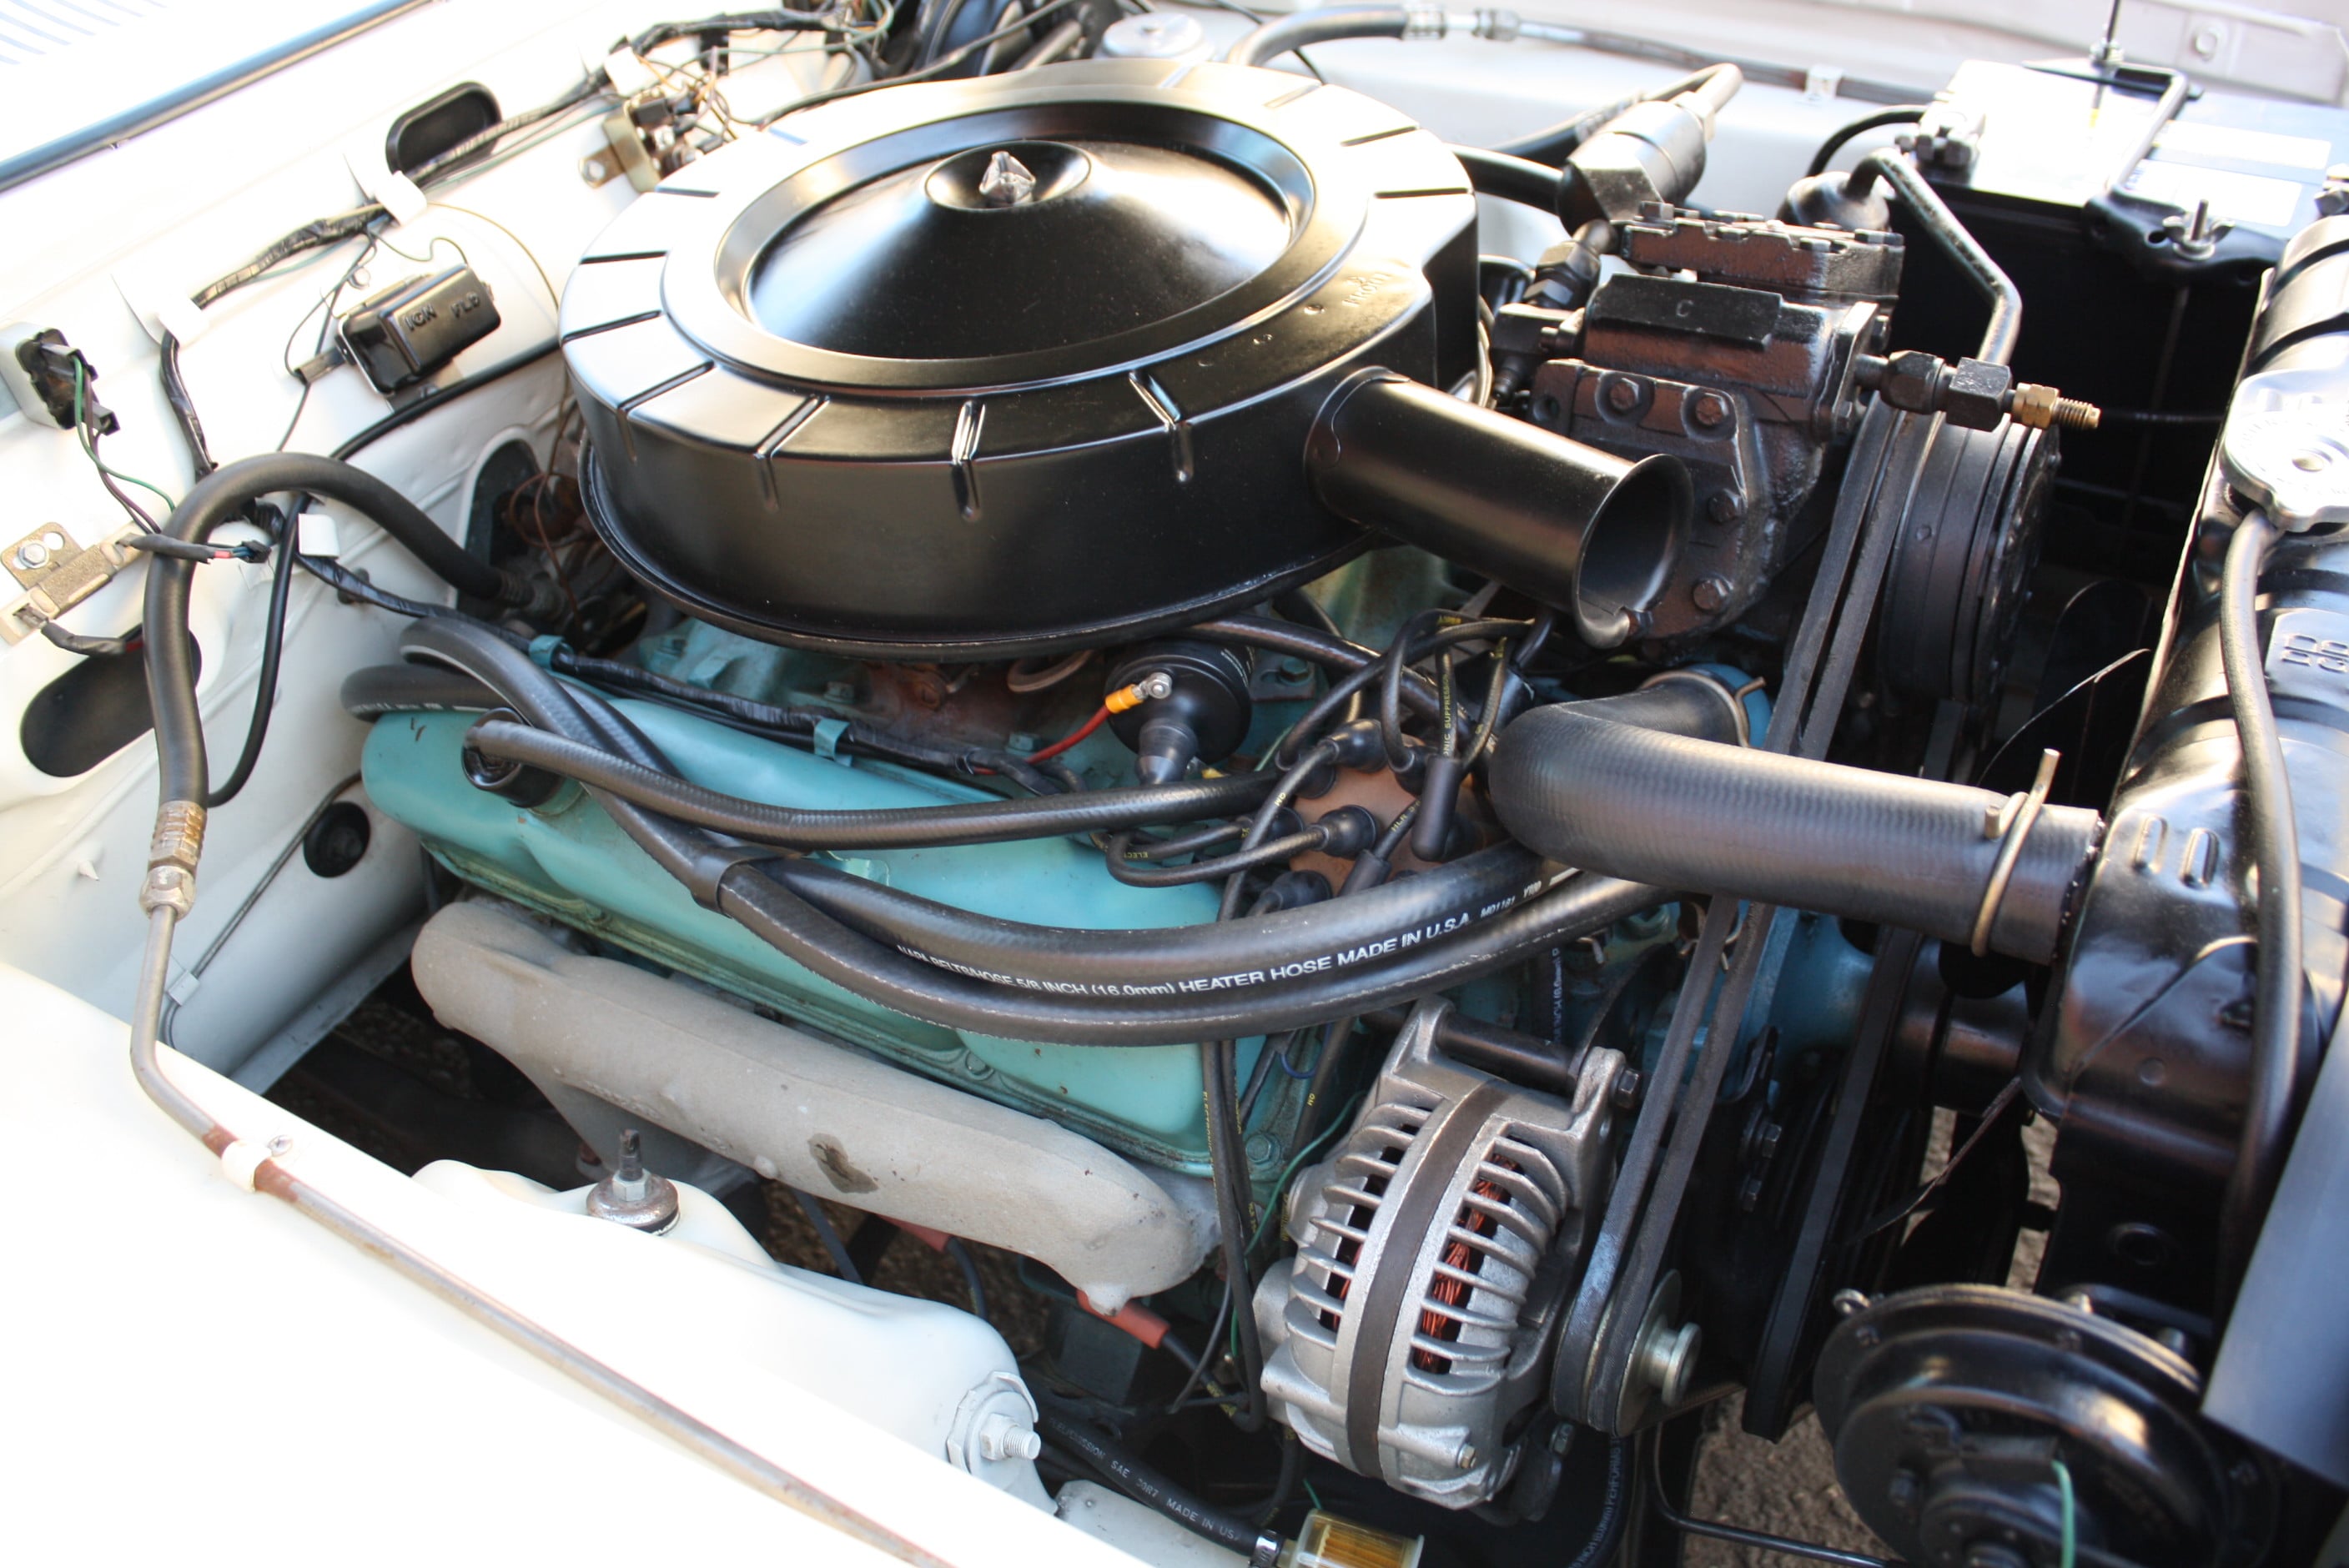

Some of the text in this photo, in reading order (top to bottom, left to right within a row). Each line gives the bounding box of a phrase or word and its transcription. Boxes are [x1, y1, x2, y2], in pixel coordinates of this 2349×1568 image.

[403, 304, 437, 331] IGN
[1015, 978, 1042, 991] 5/8
[1043, 982, 1088, 995] INCH
[1092, 983, 1175, 996] (16.0mm)
[1179, 971, 1265, 993] HEATER
[1270, 956, 1332, 980] HOSE
[1337, 937, 1398, 966] MADE
[1401, 929, 1422, 948] IN
[1110, 1460, 1130, 1479] SAE
[1166, 1498, 1199, 1522] MADE
[1201, 1518, 1215, 1530] IN
